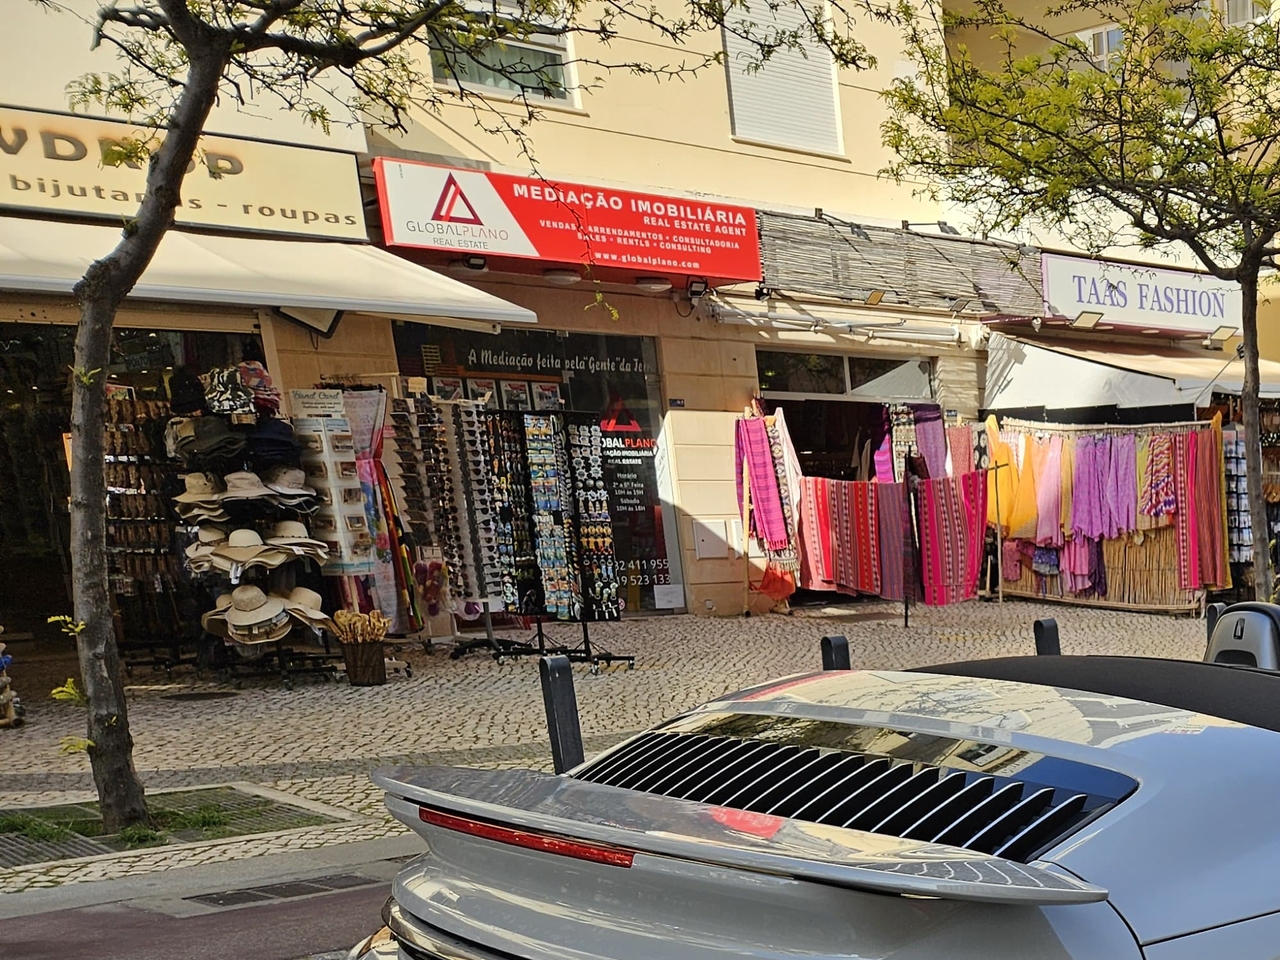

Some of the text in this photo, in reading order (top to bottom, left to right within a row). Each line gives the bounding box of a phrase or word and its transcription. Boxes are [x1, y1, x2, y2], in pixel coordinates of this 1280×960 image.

[9, 174, 358, 226] bijutars roupas
[513, 183, 746, 226] MEDIAÇÃO IMOBILIÁRIA
[406, 221, 509, 241] GLOBALPLANO
[539, 219, 740, 249] VENDAS ARRENDAMENTOS CONSULTADORIA
[643, 216, 747, 237] REAL ESTATE AGENT
[433, 237, 489, 249] REAL ESTATE
[659, 241, 712, 254] CONSULTING
[594, 251, 700, 269] www.globalplano.com
[1072, 275, 1226, 318] TAAS FASHION
[468, 348, 477, 366] A
[481, 349, 533, 370] Mediação
[536, 353, 561, 371] feita
[628, 559, 647, 570] 411
[650, 558, 669, 569] 955
[630, 574, 650, 586] 523
[652, 573, 670, 584] 133
